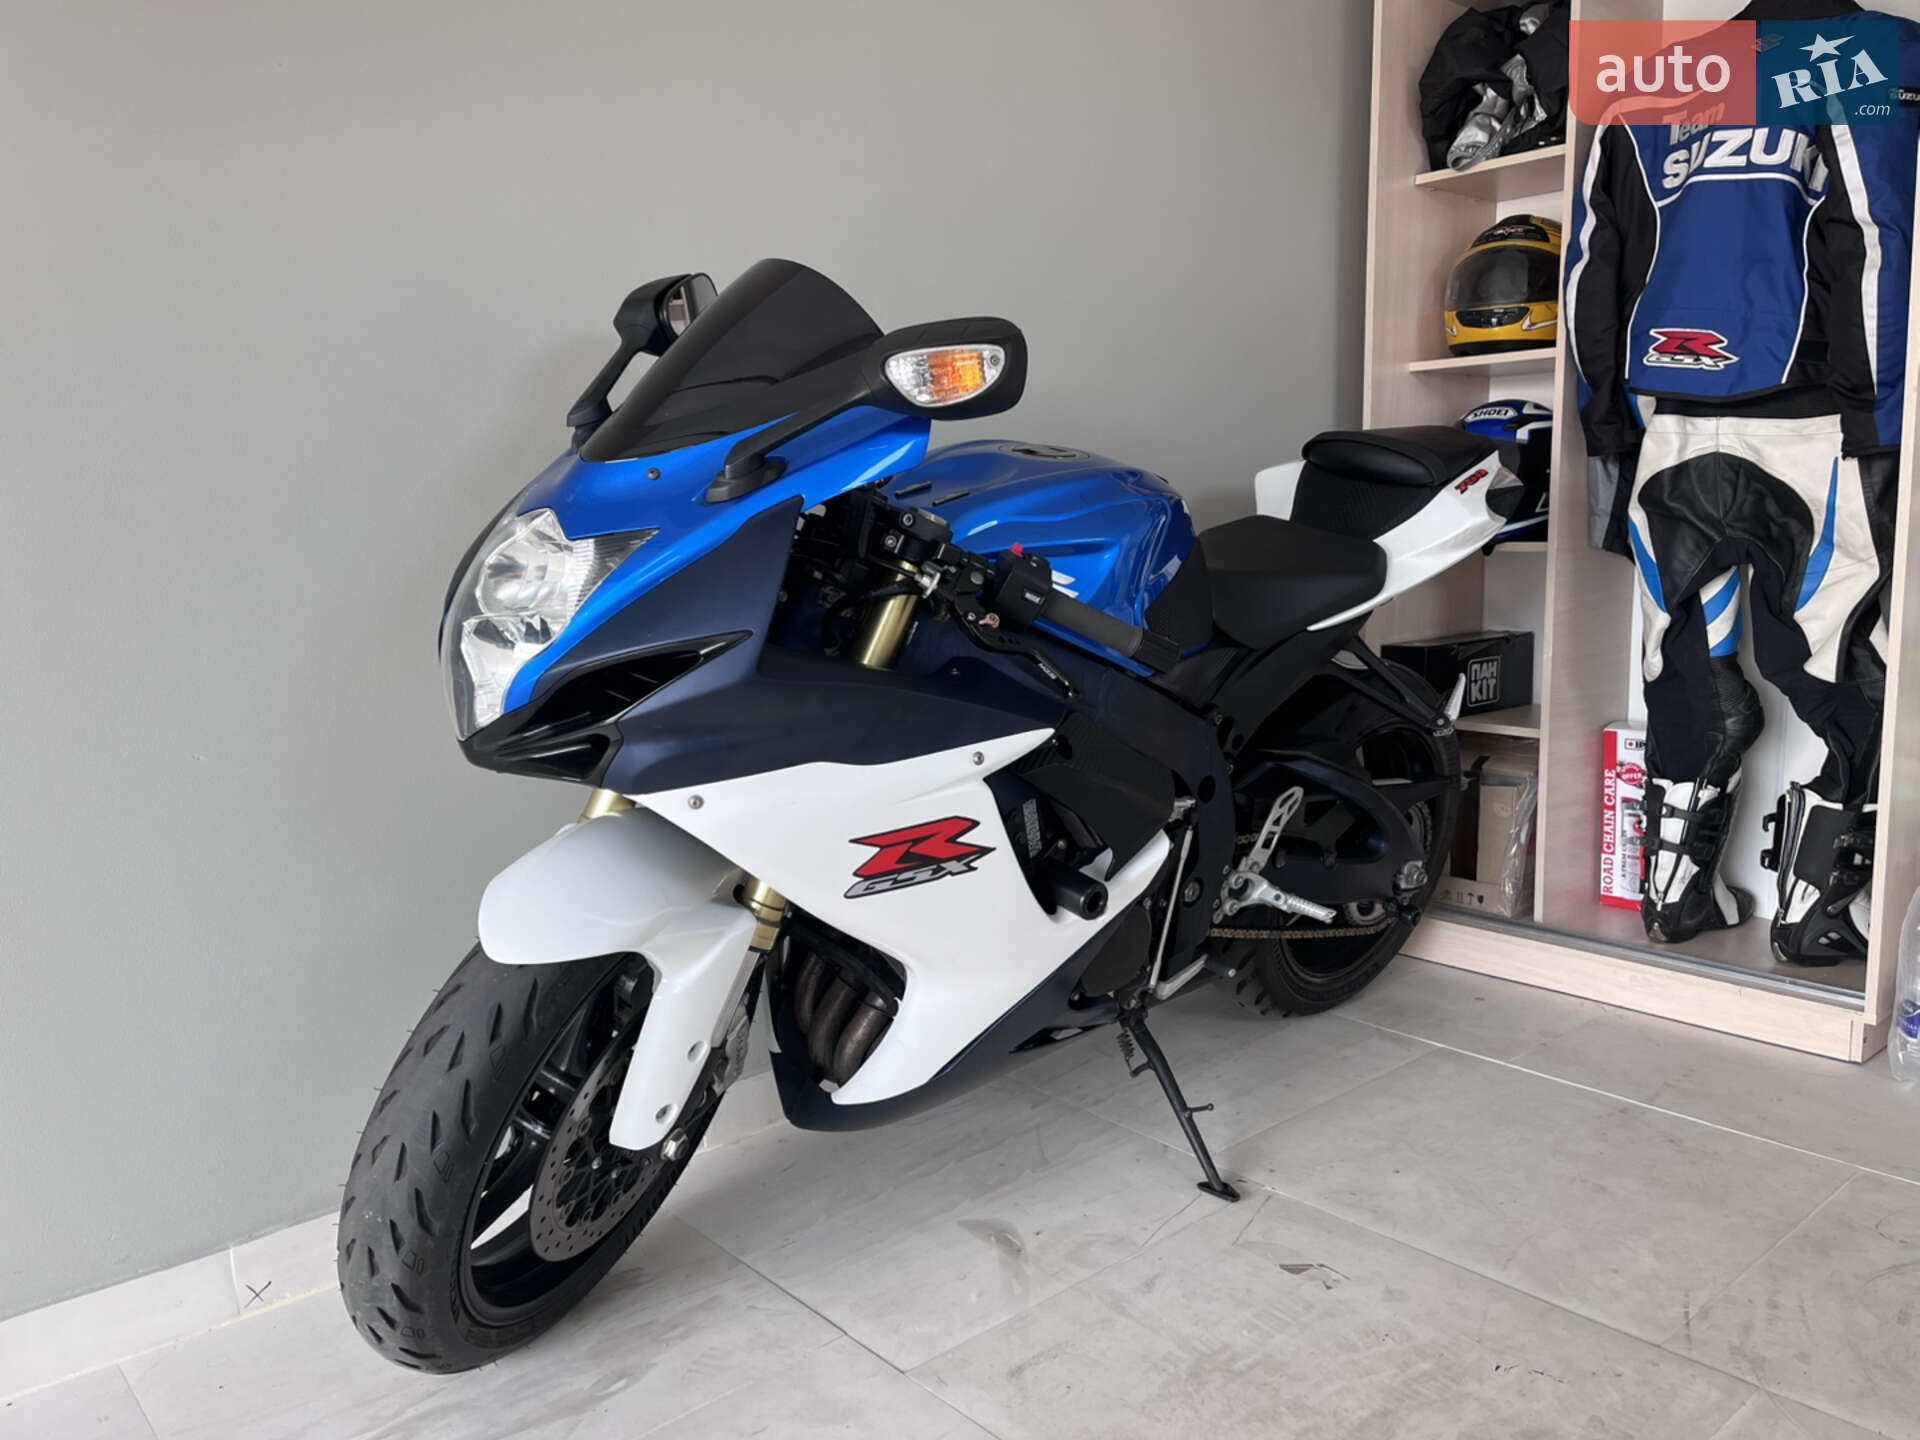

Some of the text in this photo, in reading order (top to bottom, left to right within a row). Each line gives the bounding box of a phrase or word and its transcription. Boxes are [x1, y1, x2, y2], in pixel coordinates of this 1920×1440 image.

[1662, 102, 1725, 146] Team
[1662, 127, 1829, 190] SUZUKI
[1473, 408, 1509, 417] SHOEI
[849, 816, 997, 878] R
[1602, 768, 1616, 894] ROAD CHAIN CARE
[843, 853, 988, 899] GSX
